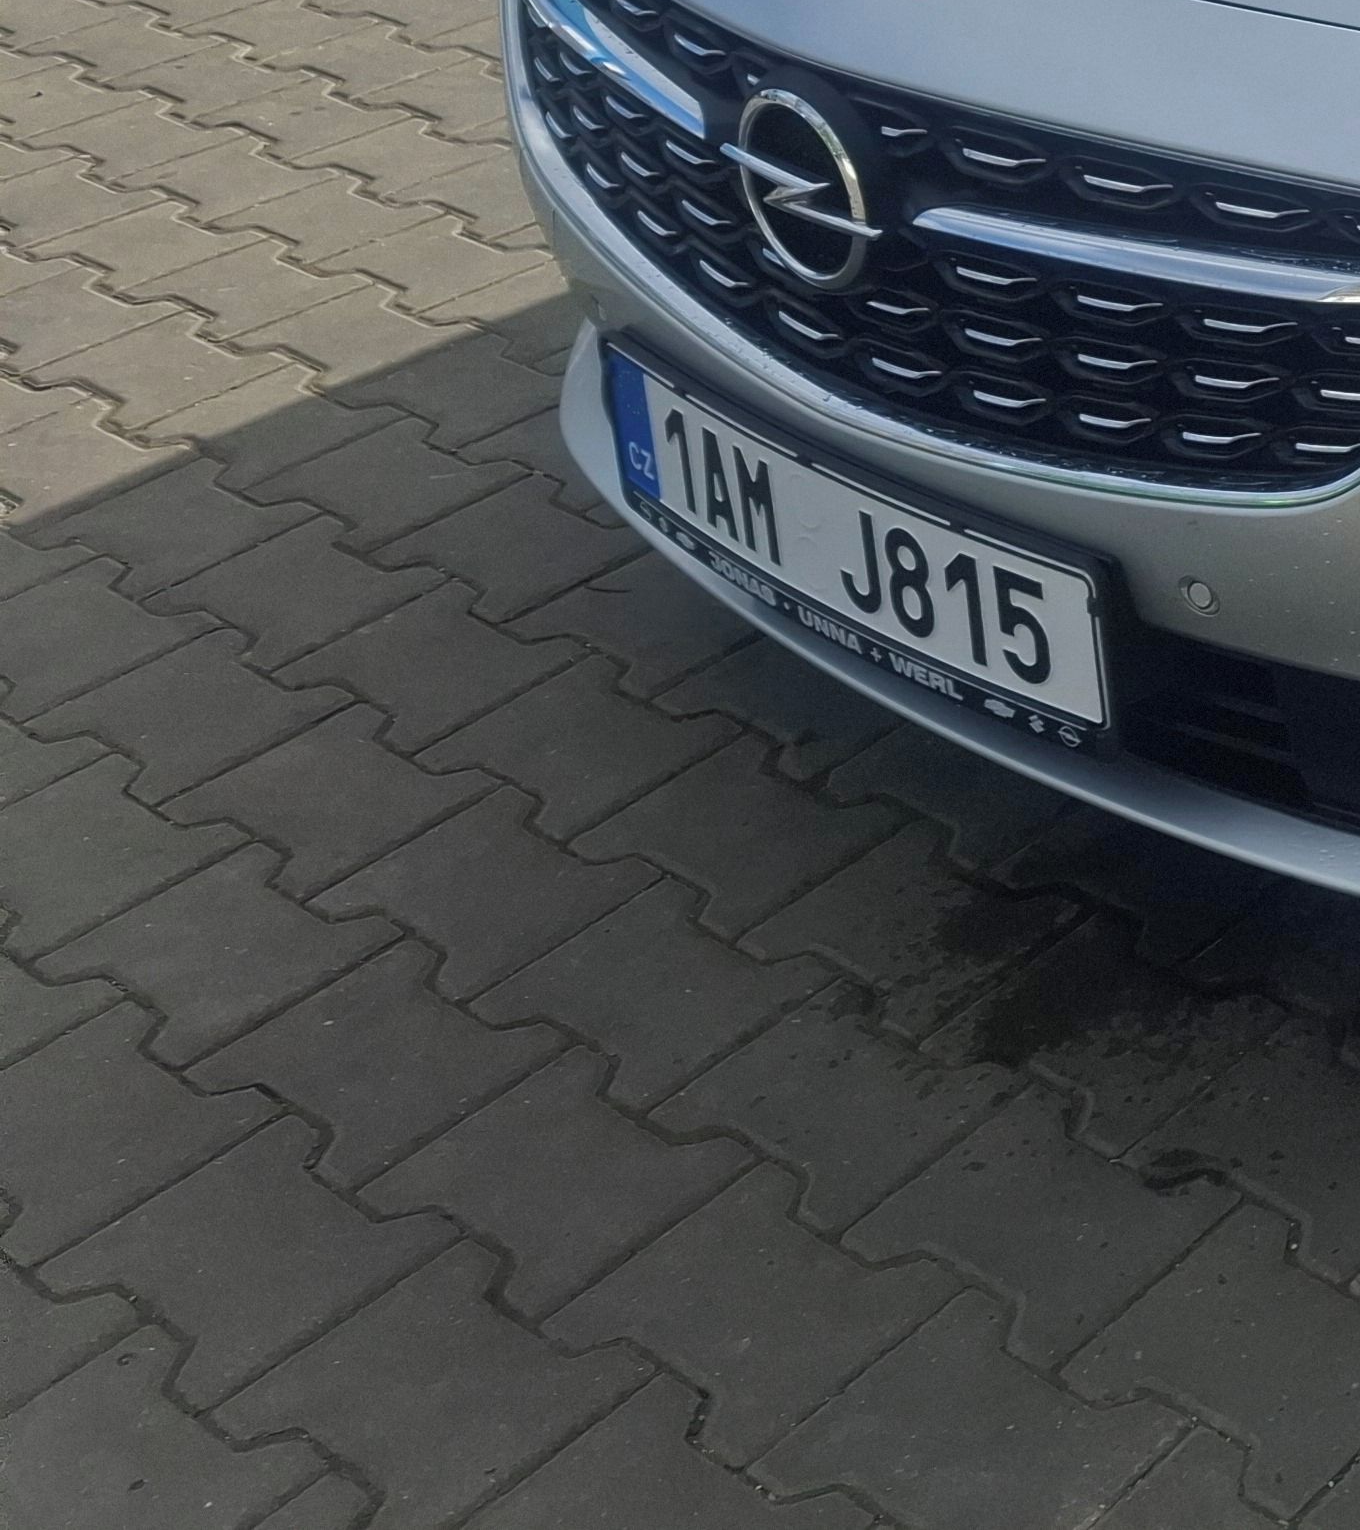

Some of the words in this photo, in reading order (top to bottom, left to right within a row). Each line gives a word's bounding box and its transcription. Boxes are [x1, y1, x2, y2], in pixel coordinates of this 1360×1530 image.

[628, 441, 655, 480] CZ
[664, 407, 782, 567] 1AM
[840, 509, 1051, 685] J815
[797, 604, 863, 655] UNNA
[888, 651, 964, 701] WERL
